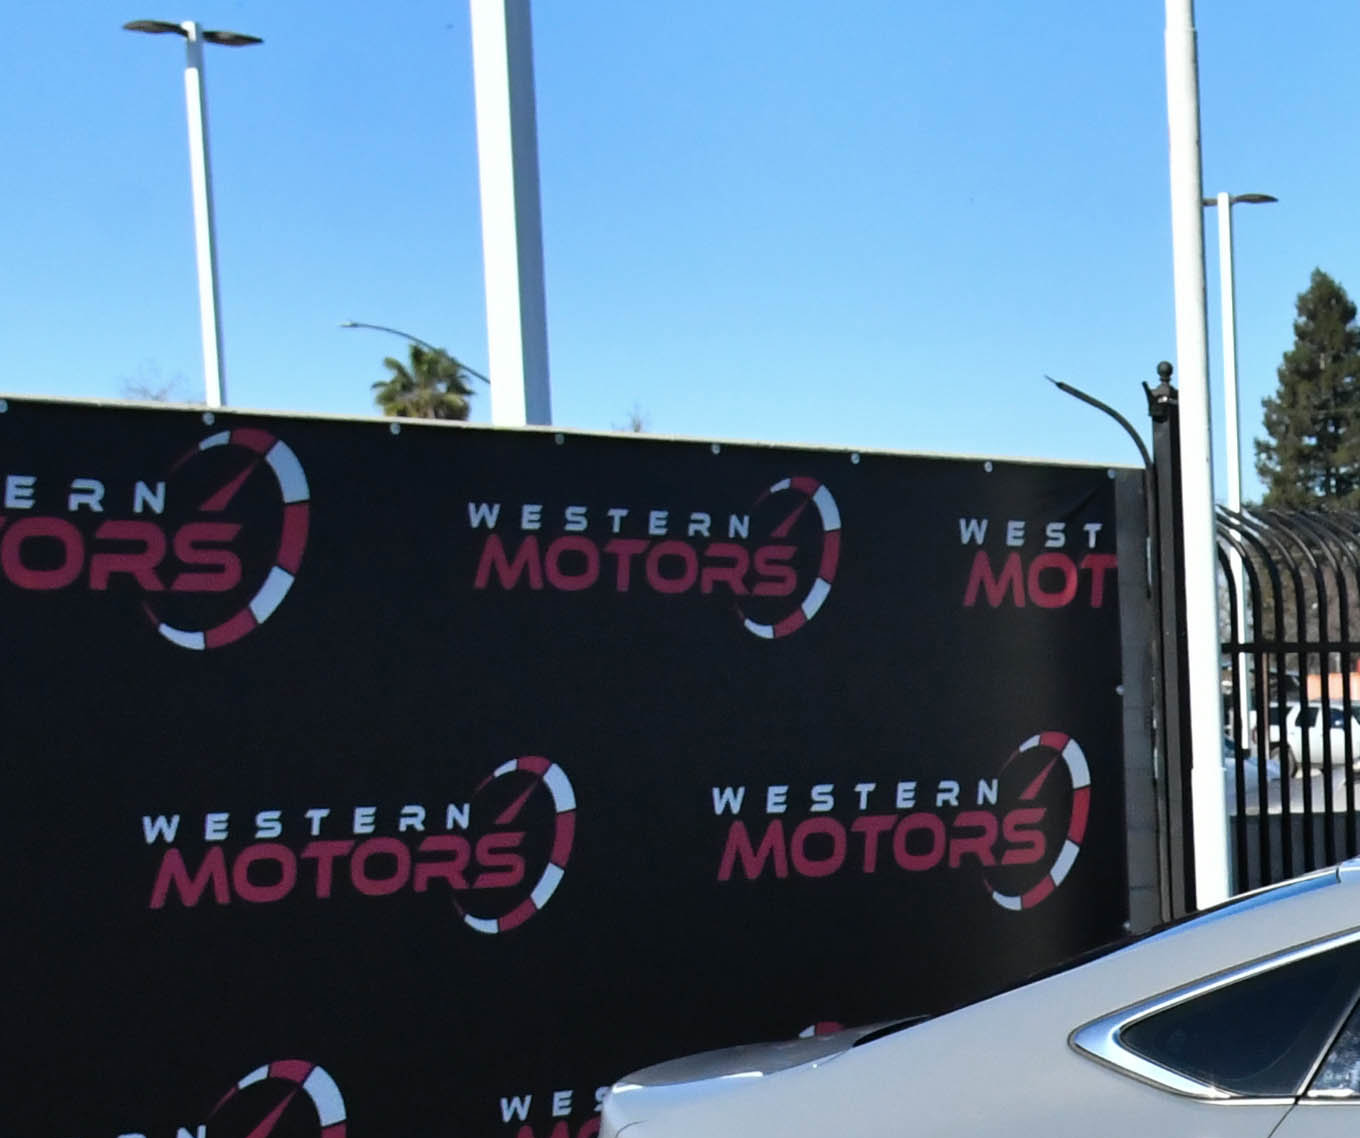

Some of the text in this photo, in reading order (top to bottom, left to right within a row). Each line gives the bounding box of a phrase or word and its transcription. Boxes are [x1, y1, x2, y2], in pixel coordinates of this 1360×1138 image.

[468, 502, 750, 538] WESTERN
[958, 517, 1103, 549] WEST
[0, 515, 243, 593] ORS
[475, 534, 798, 597] MOTORS
[963, 550, 1118, 610] MOT
[142, 802, 471, 845] WESTERN
[711, 777, 999, 816] WESTERN
[149, 830, 526, 909] MOTORS
[717, 806, 1047, 882] MOTORS
